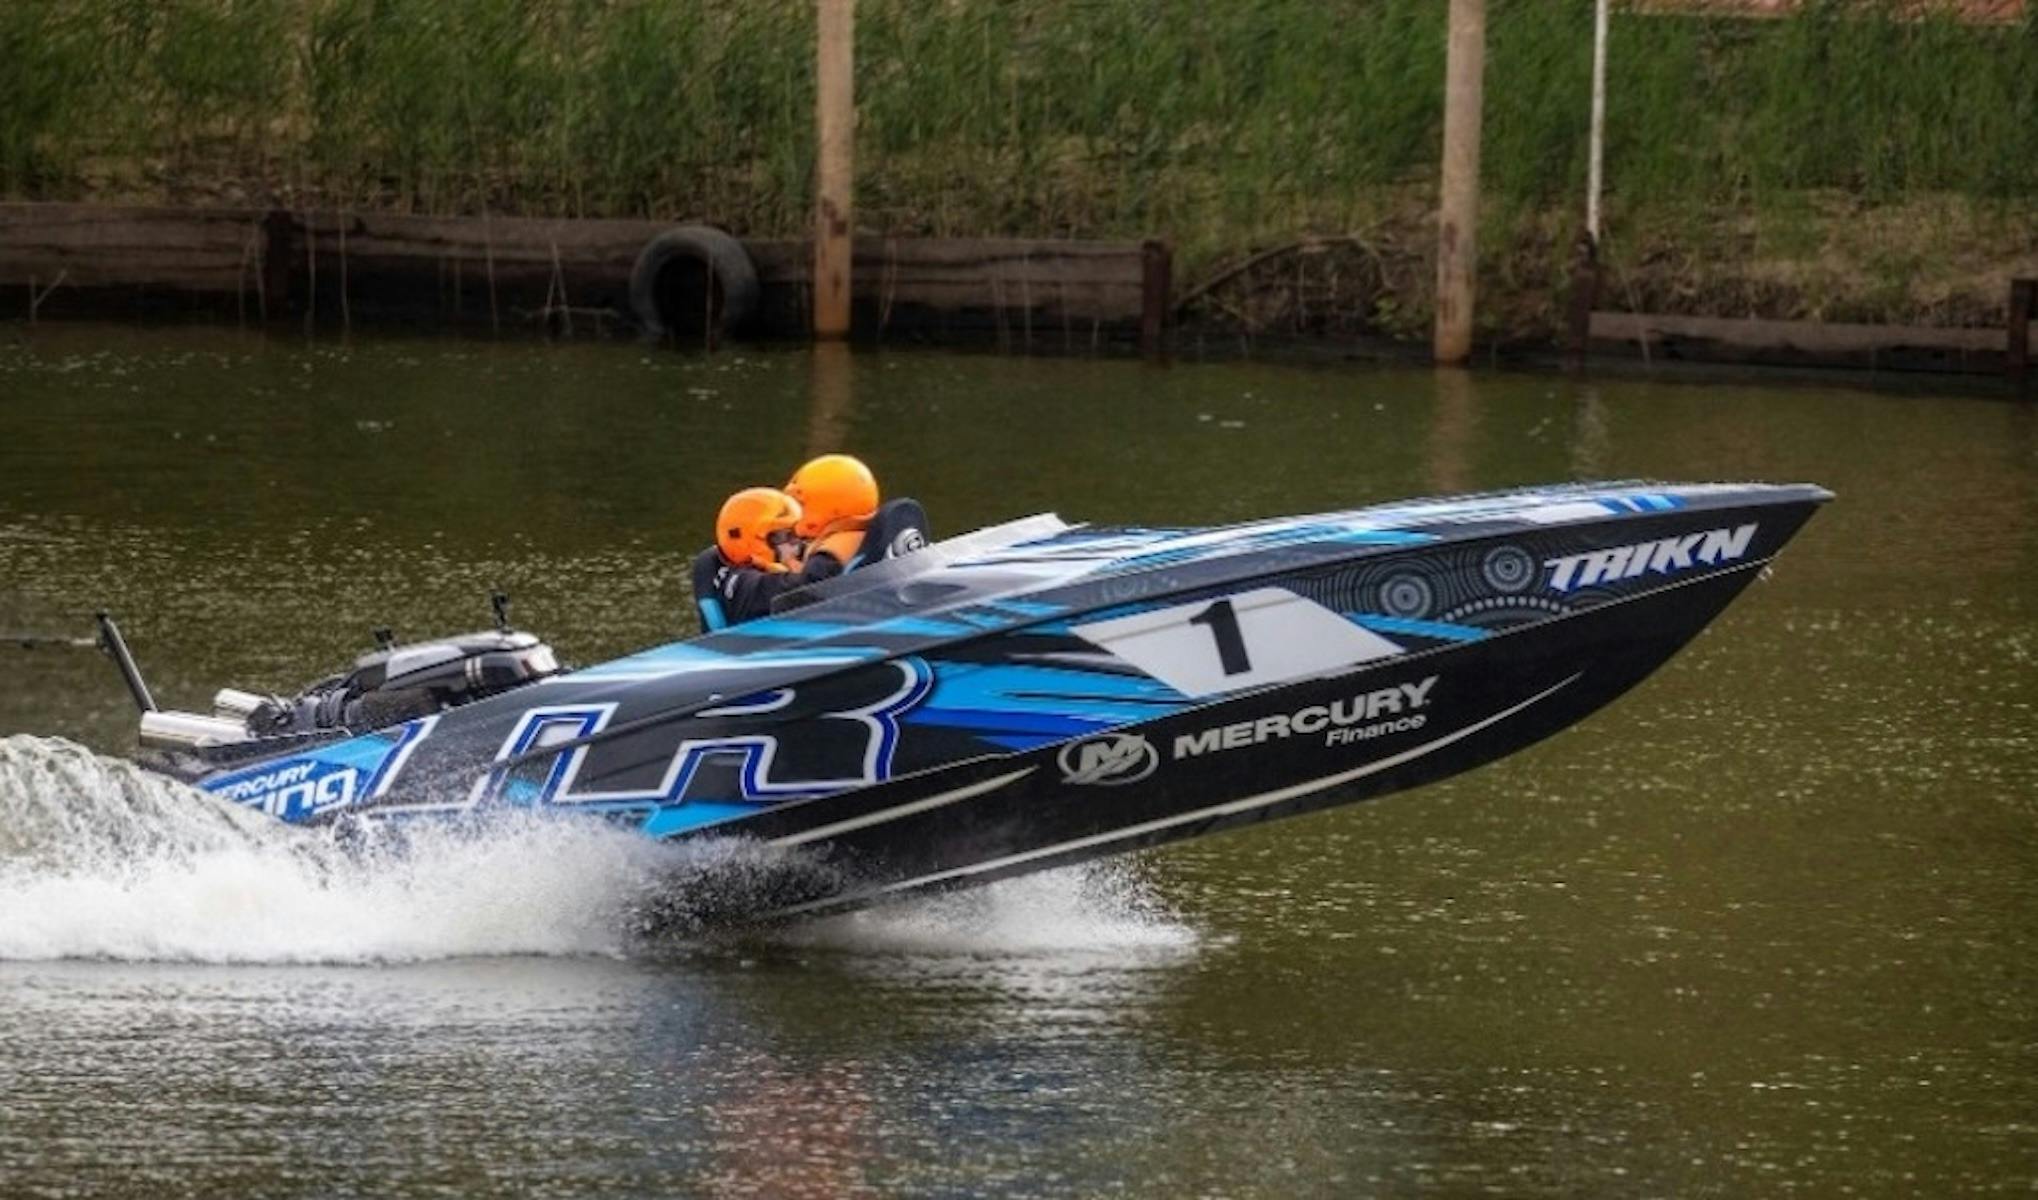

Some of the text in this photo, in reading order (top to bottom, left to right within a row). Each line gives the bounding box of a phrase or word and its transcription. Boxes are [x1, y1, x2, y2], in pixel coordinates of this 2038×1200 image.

[1188, 599, 1252, 676] 1
[1173, 675, 1440, 760] MERCURY
[1324, 714, 1427, 747] Finance
